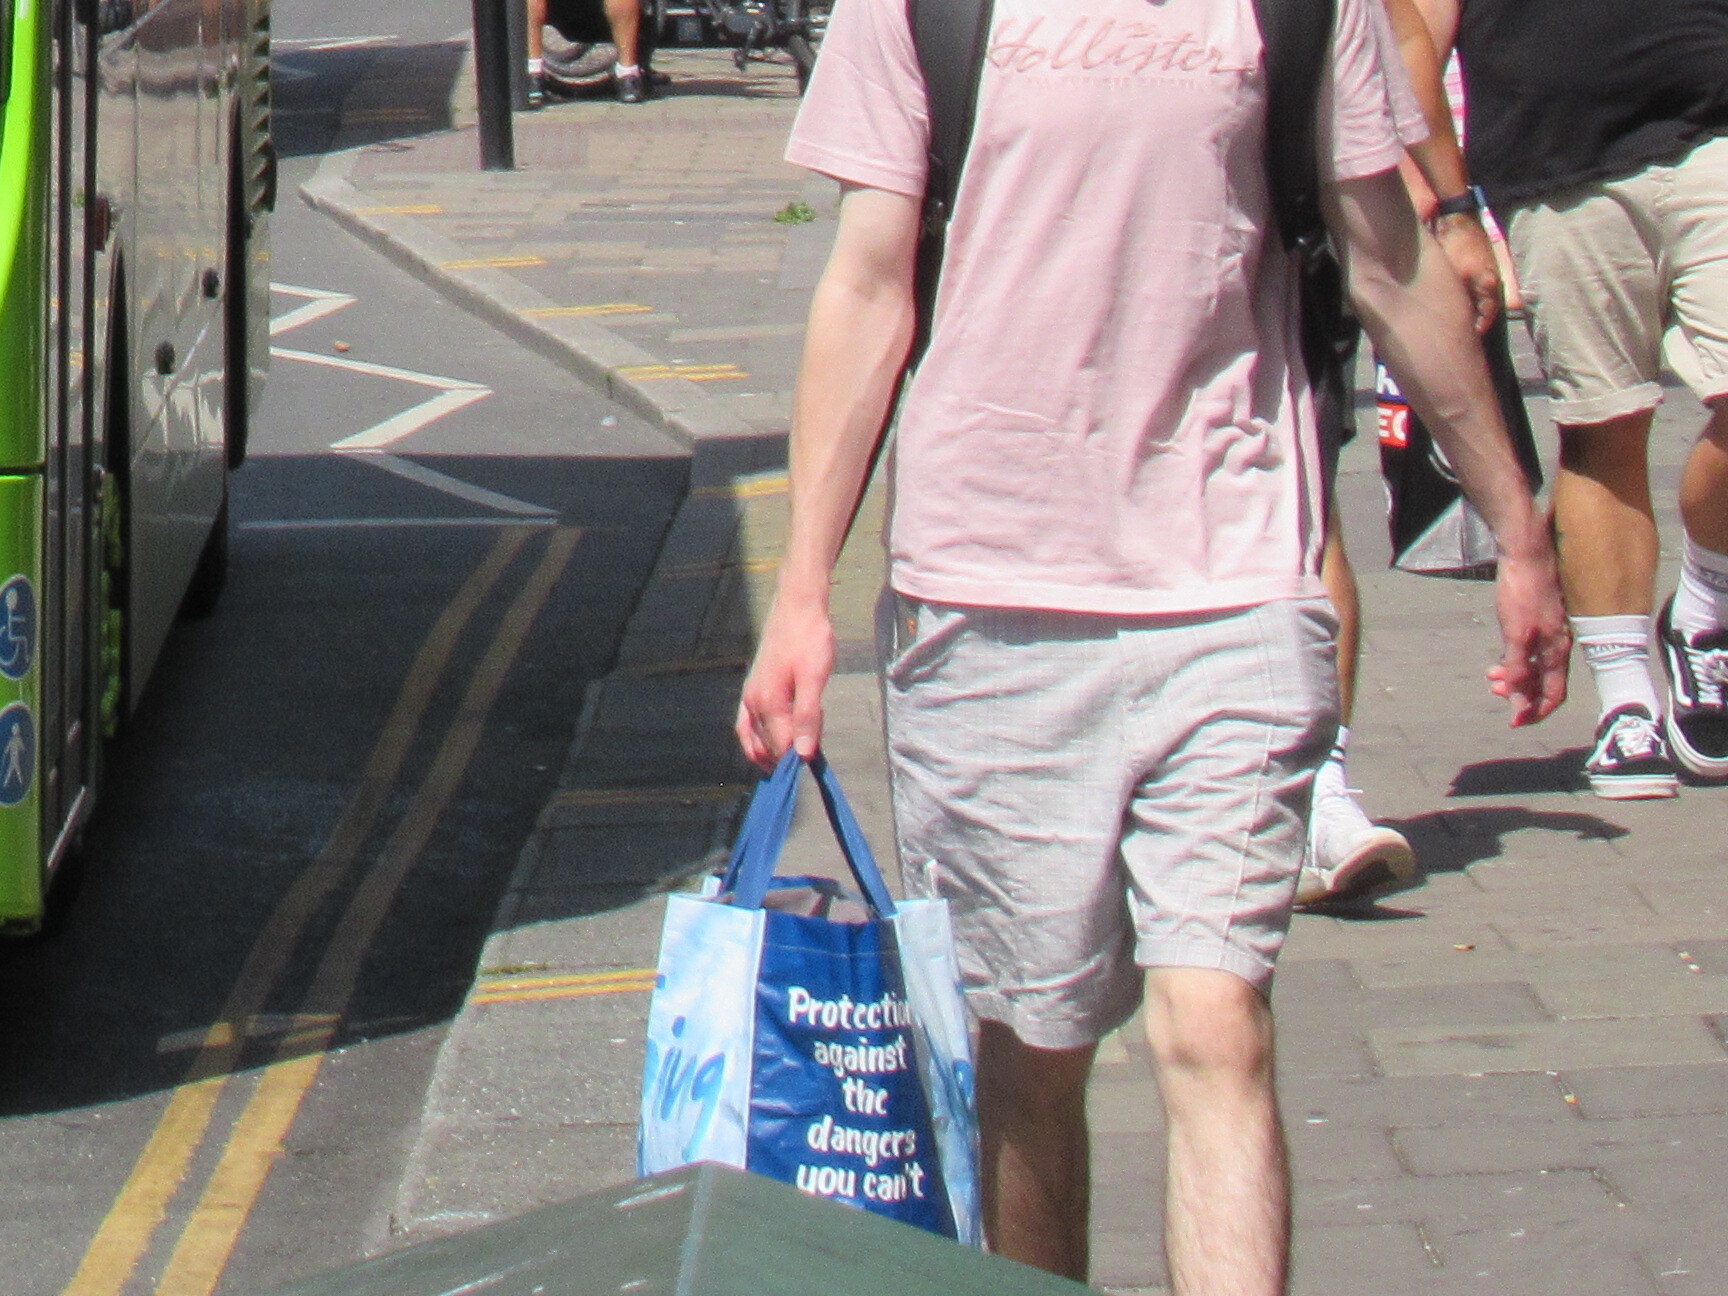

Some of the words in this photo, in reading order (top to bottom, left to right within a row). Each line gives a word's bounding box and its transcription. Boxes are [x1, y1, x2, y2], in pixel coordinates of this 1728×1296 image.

[990, 14, 1261, 74] Hollister
[812, 1033, 909, 1078] against
[843, 1077, 889, 1117] the
[807, 1114, 918, 1167] dangers
[796, 1164, 857, 1199] you
[863, 1161, 927, 1202] can't
